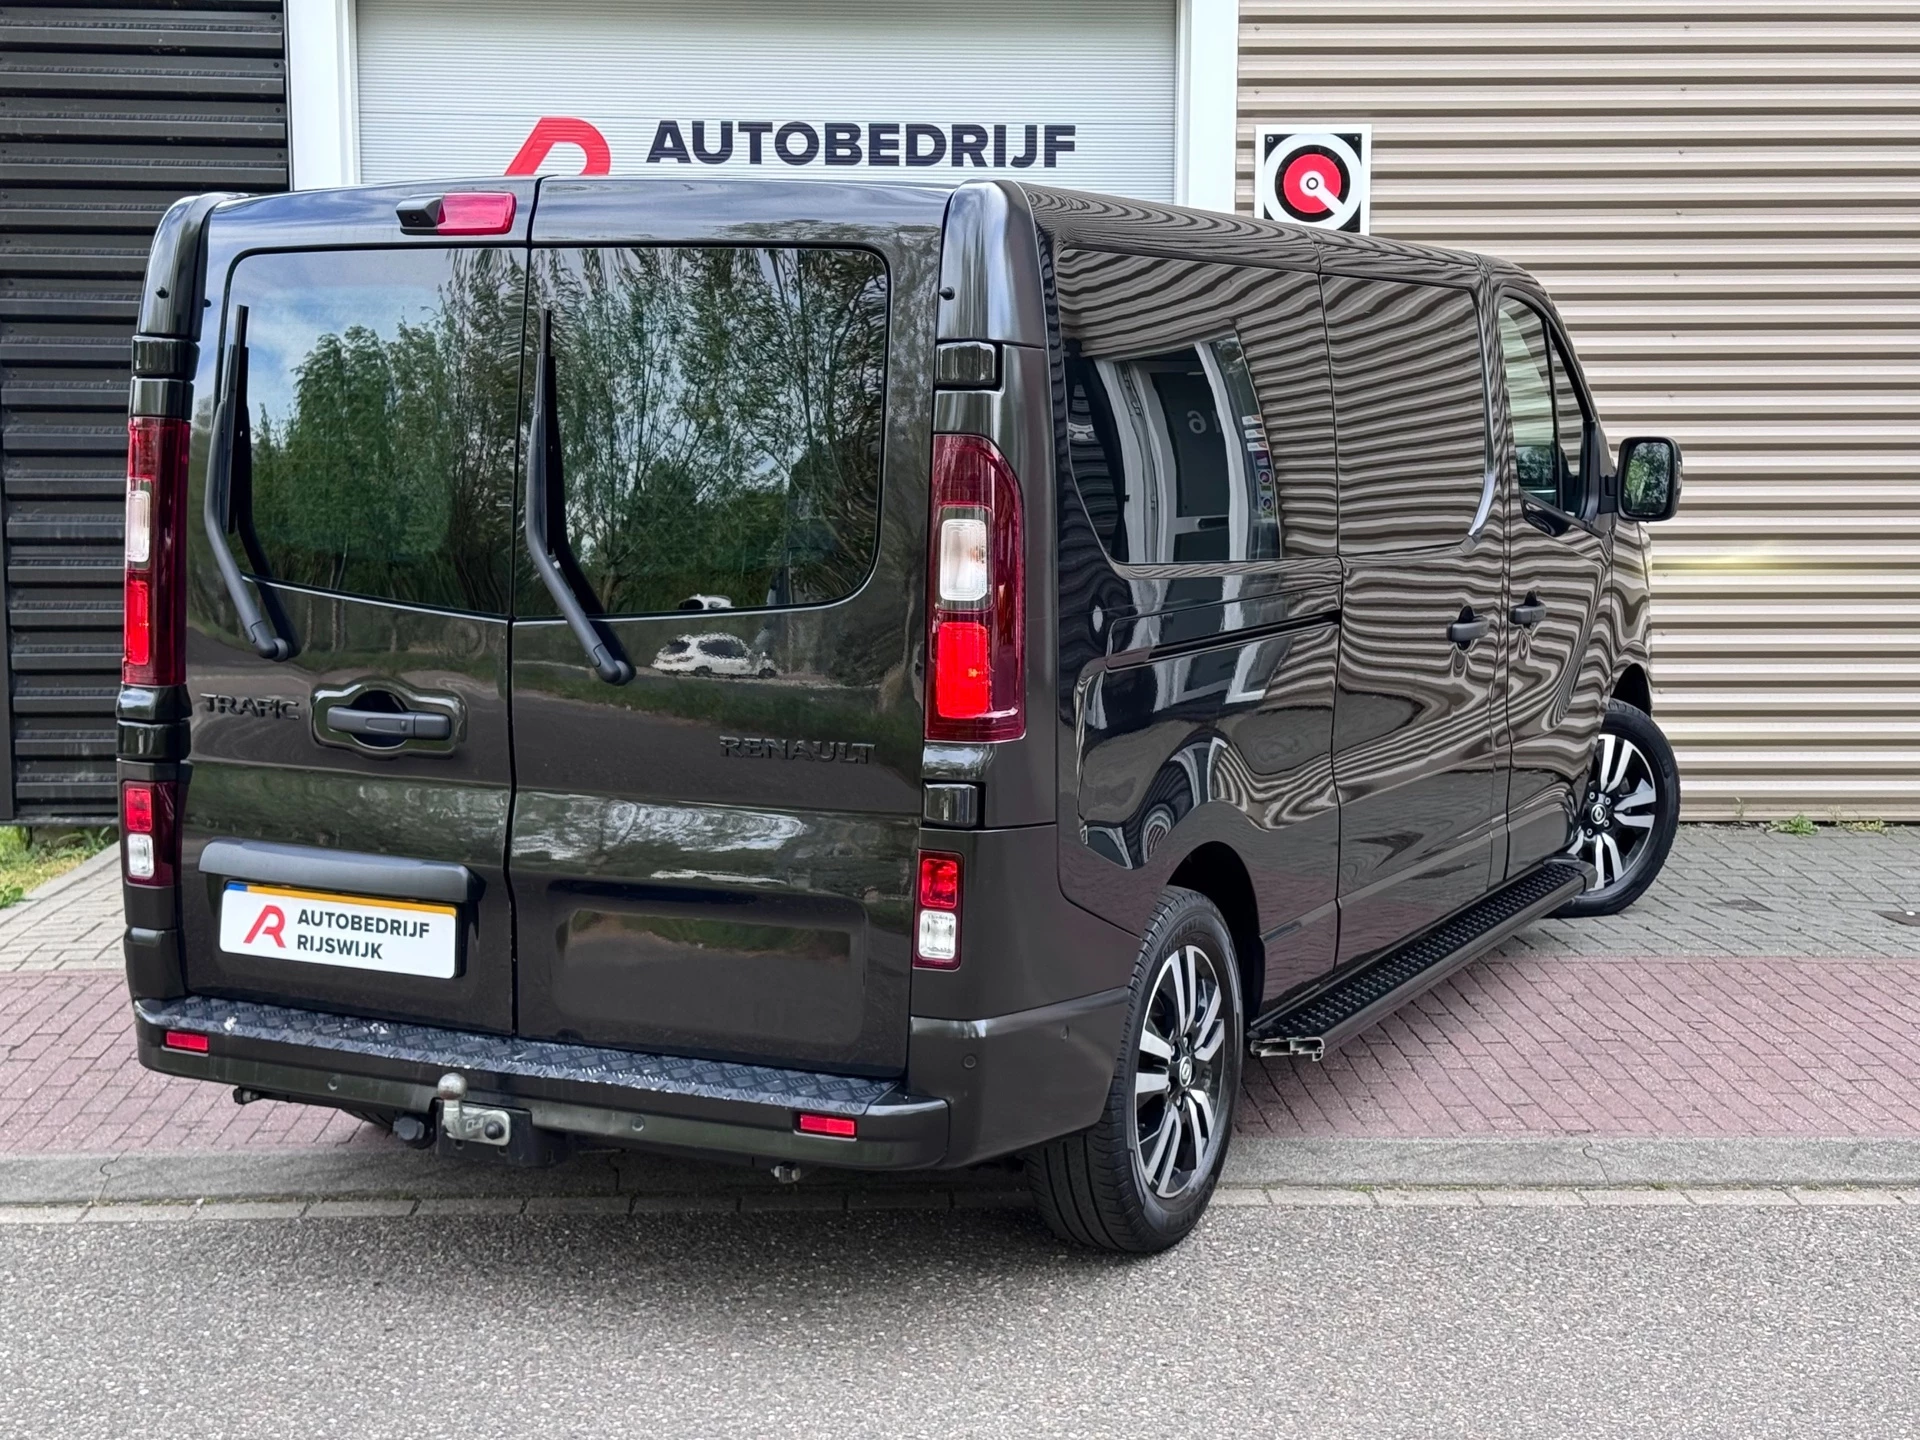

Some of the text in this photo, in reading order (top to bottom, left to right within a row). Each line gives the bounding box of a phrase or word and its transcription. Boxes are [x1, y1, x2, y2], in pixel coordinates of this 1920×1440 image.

[646, 119, 1076, 168] AUTOBEDRIJF
[200, 693, 300, 720] TRAFIC
[719, 735, 877, 764] RENAULT
[297, 909, 430, 939] AUTOBEDRIJF
[297, 934, 383, 960] RIJSWIJK
